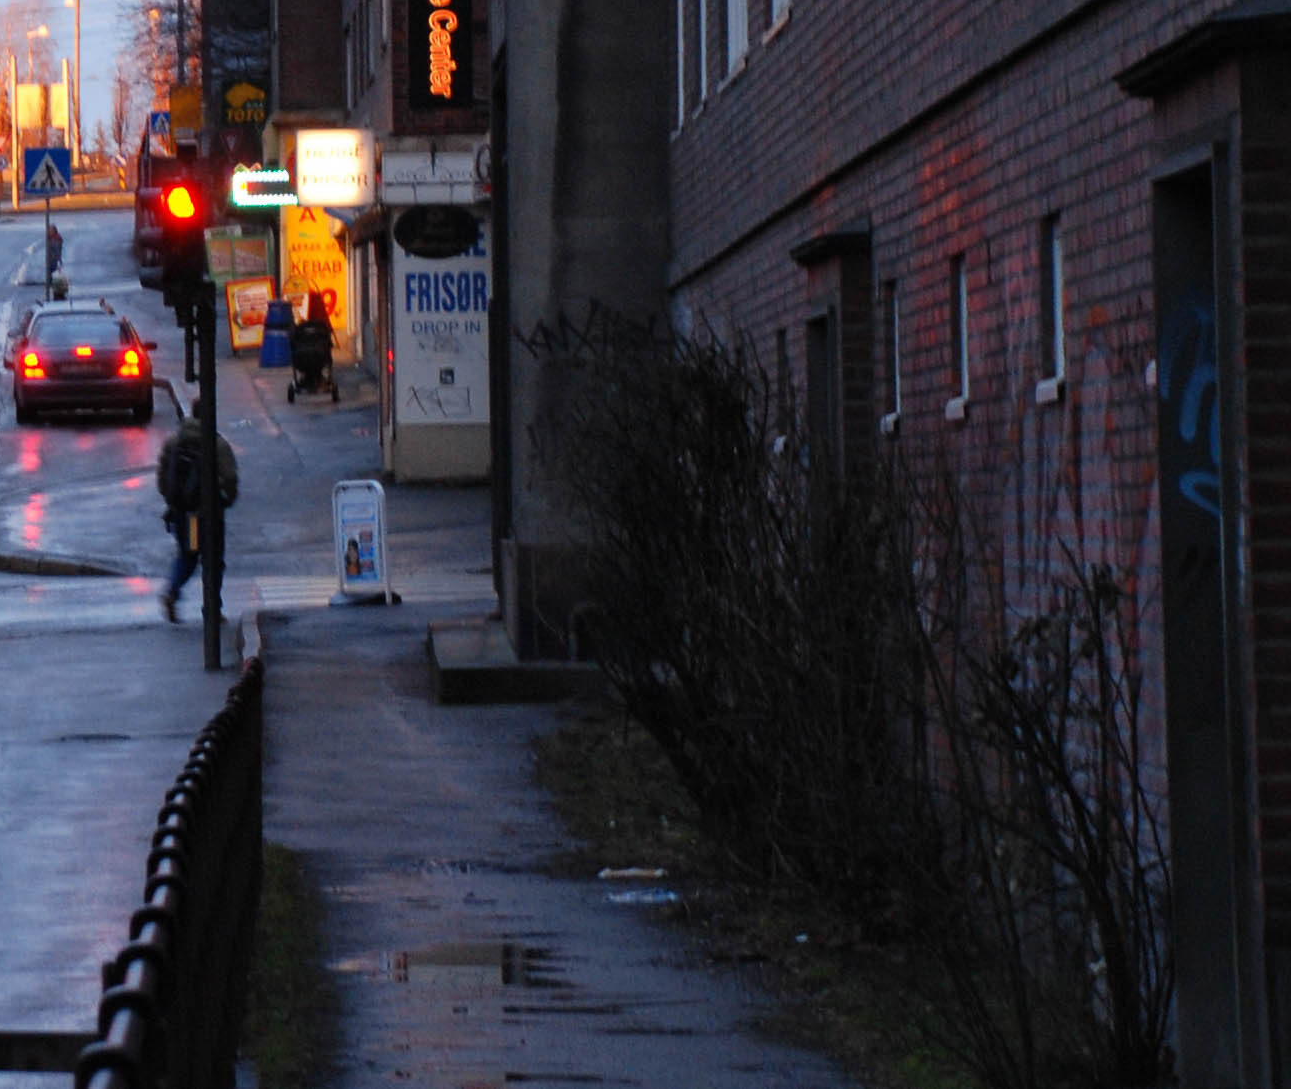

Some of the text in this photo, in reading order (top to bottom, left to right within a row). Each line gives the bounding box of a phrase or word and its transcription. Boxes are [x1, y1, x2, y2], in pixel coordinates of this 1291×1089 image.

[428, 9, 458, 99] Center
[405, 271, 488, 313] FRISØR
[412, 319, 481, 335] DROP IN
